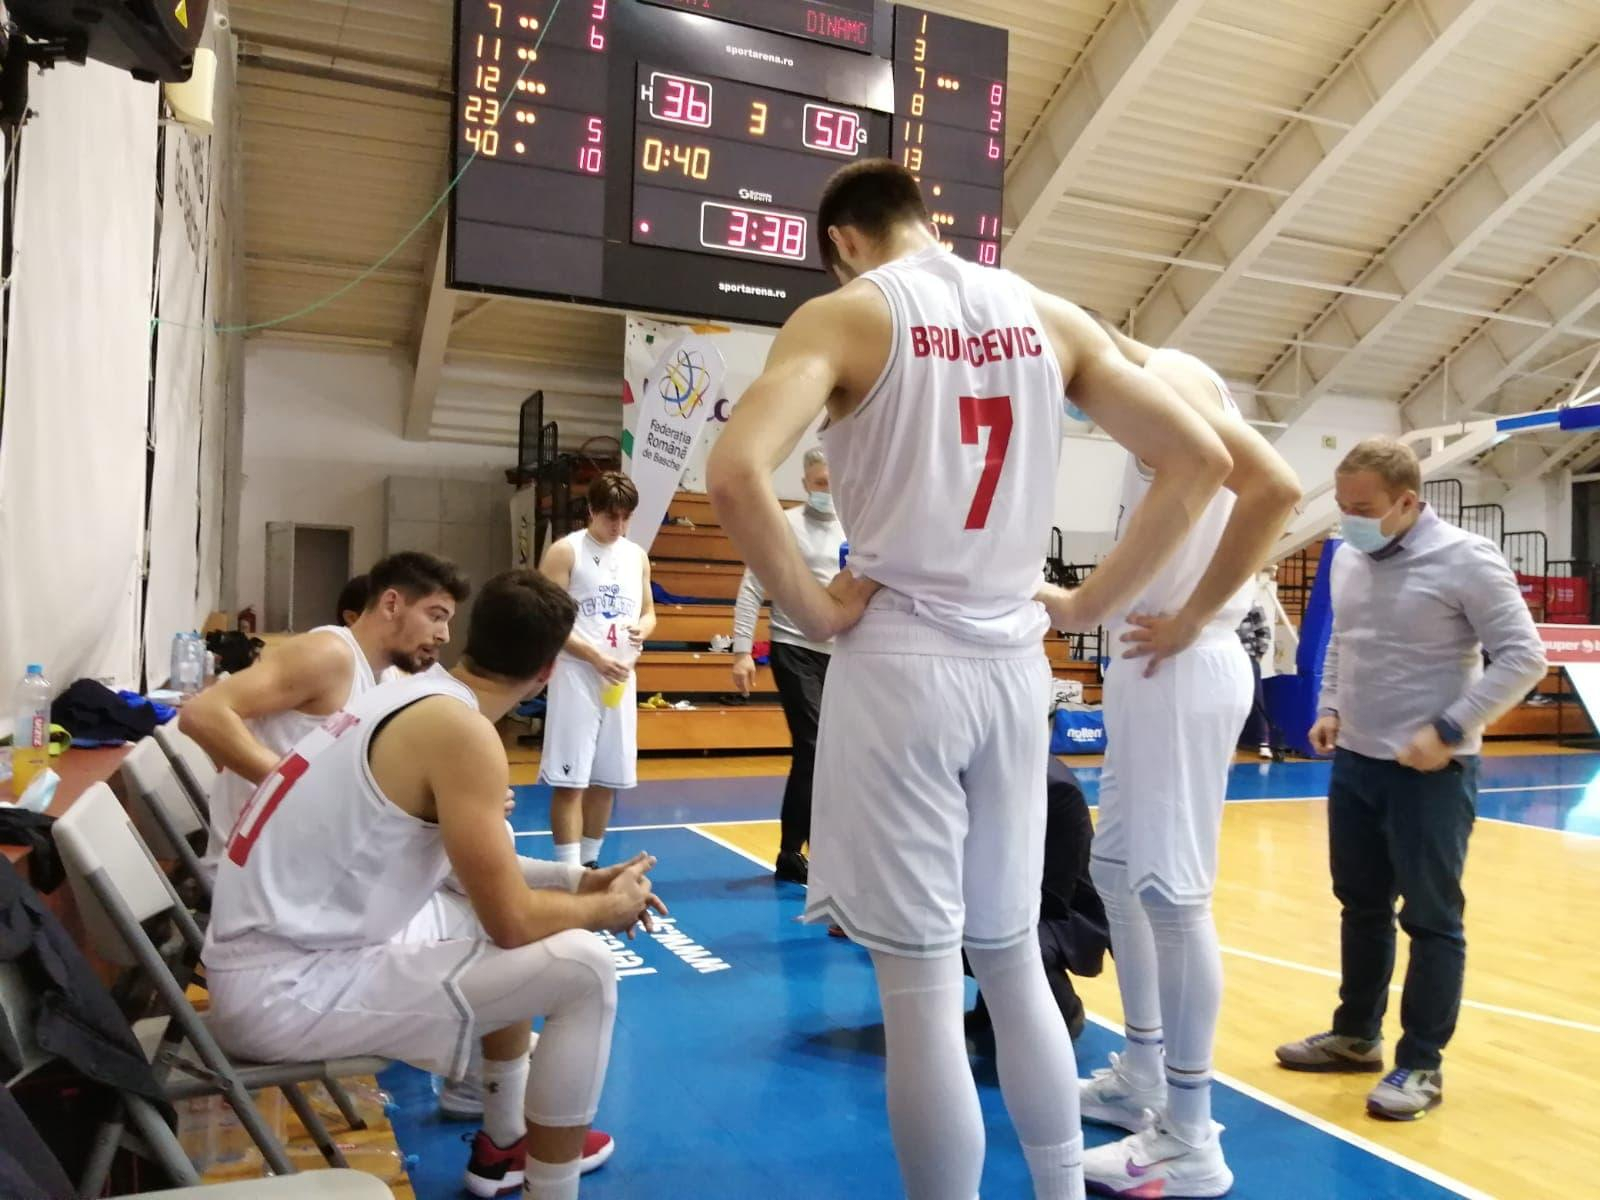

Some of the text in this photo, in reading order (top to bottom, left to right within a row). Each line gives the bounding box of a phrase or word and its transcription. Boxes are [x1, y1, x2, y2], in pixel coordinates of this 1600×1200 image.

[488, 3, 502, 28] 7
[806, 10, 868, 45] DINAMO
[921, 14, 928, 34] 1
[477, 34, 501, 61] 11
[590, 26, 604, 49] 6
[725, 44, 794, 68] sportarena.ro
[914, 38, 926, 62] 3
[476, 66, 500, 92] 12
[915, 66, 926, 89] 7
[664, 80, 707, 123] 36
[911, 93, 925, 116] 8
[990, 84, 1002, 106] 8
[465, 95, 499, 125] 23
[749, 102, 767, 136] 3
[989, 110, 1001, 132] 2
[465, 127, 499, 156] 40
[588, 119, 602, 143] 5
[815, 111, 856, 150] 50
[856, 128, 868, 144] G
[904, 121, 924, 143] 11
[579, 147, 602, 173] 10
[643, 138, 710, 180] 0:40
[903, 148, 922, 171] 13
[988, 138, 1000, 159] 6
[727, 210, 804, 256] 3:38
[980, 216, 998, 237] 11
[979, 243, 997, 265] 10
[718, 282, 787, 299] sportarena.ro
[910, 326, 1042, 368] BRUCEVIC
[642, 449, 652, 460] de
[958, 395, 1014, 530] 7
[606, 623, 618, 648] 4
